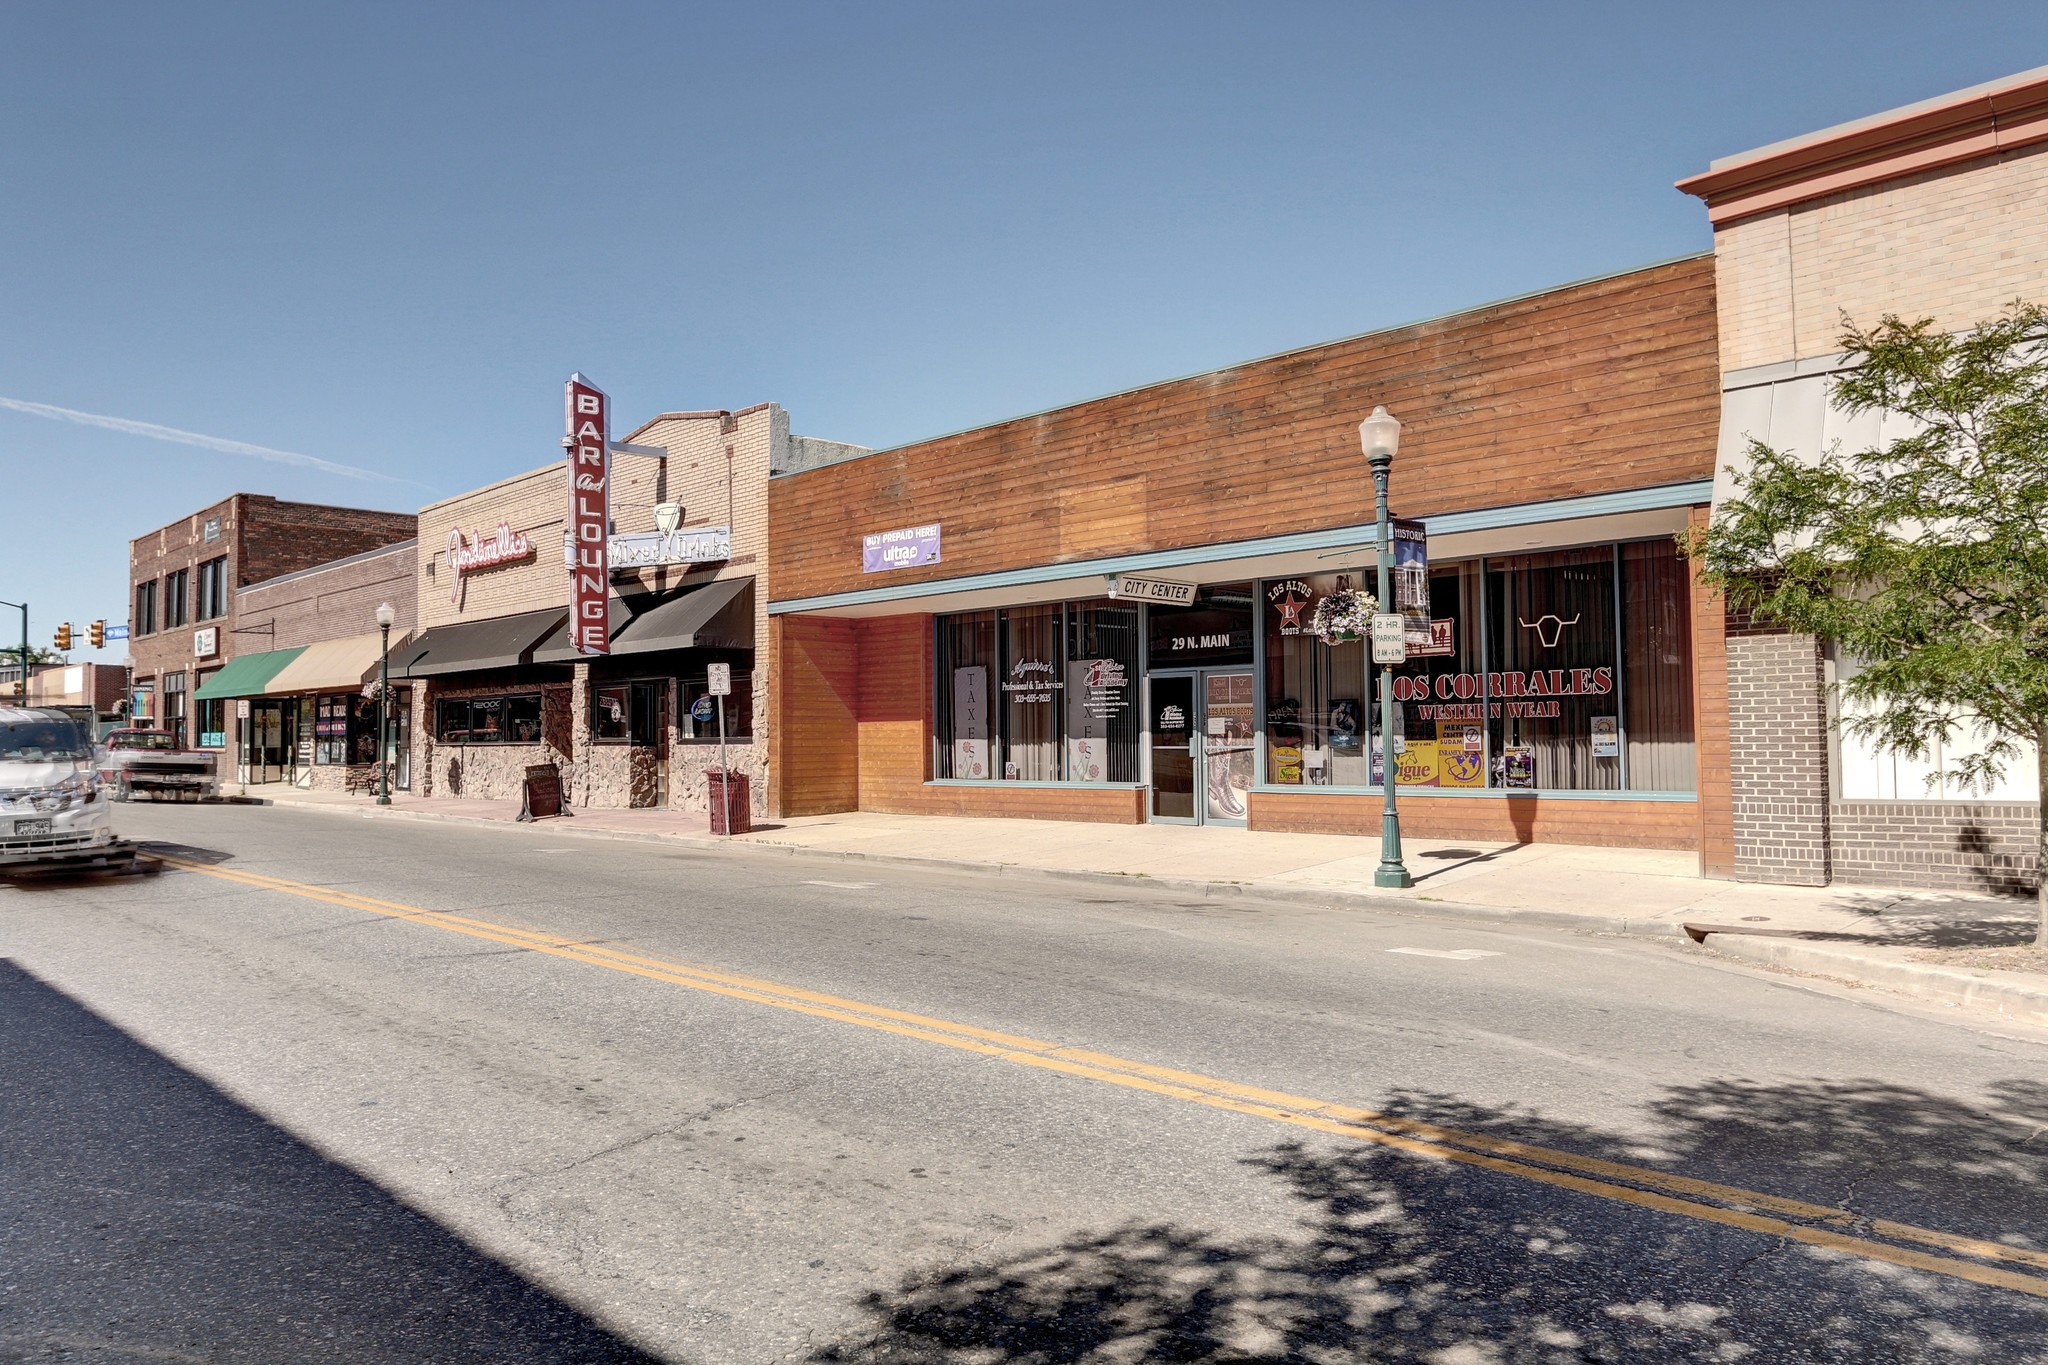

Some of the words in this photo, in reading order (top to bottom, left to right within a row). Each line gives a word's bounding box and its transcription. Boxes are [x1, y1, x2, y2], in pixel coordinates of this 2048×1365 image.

[577, 393, 602, 467] BAR
[575, 472, 606, 494] And
[866, 535, 881, 547] BUY
[882, 529, 914, 544] PREPAID
[915, 525, 937, 539] HERE!
[1394, 527, 1426, 542] HISTORIC
[676, 533, 730, 561] Drinks
[883, 545, 910, 562] ultra
[579, 496, 604, 646] LOUNGE
[1124, 580, 1148, 595] CITY
[1151, 584, 1189, 600] CENTER
[1267, 582, 1285, 601] LOS
[1285, 580, 1313, 598] ALTOS
[1280, 627, 1300, 636] BOOTS
[1376, 620, 1383, 629] 2
[1385, 620, 1401, 629] HR.
[1171, 637, 1185, 650] 29
[1187, 636, 1199, 649] N.
[1200, 633, 1230, 648] MAIN
[1375, 633, 1402, 642] PARKING
[1395, 648, 1402, 656] PM
[1001, 680, 1029, 691] Professional
[1029, 680, 1034, 690] &
[1035, 680, 1045, 690] Tax
[1045, 679, 1064, 690] Services
[1435, 666, 1613, 699] CORRALES
[967, 673, 976, 759] TAXES
[1219, 707, 1236, 715] ALTOS
[1237, 706, 1254, 715] BOOTS
[1417, 702, 1501, 720] WESTERN
[1507, 701, 1560, 719] WEAR
[1279, 767, 1298, 780] Sigue
